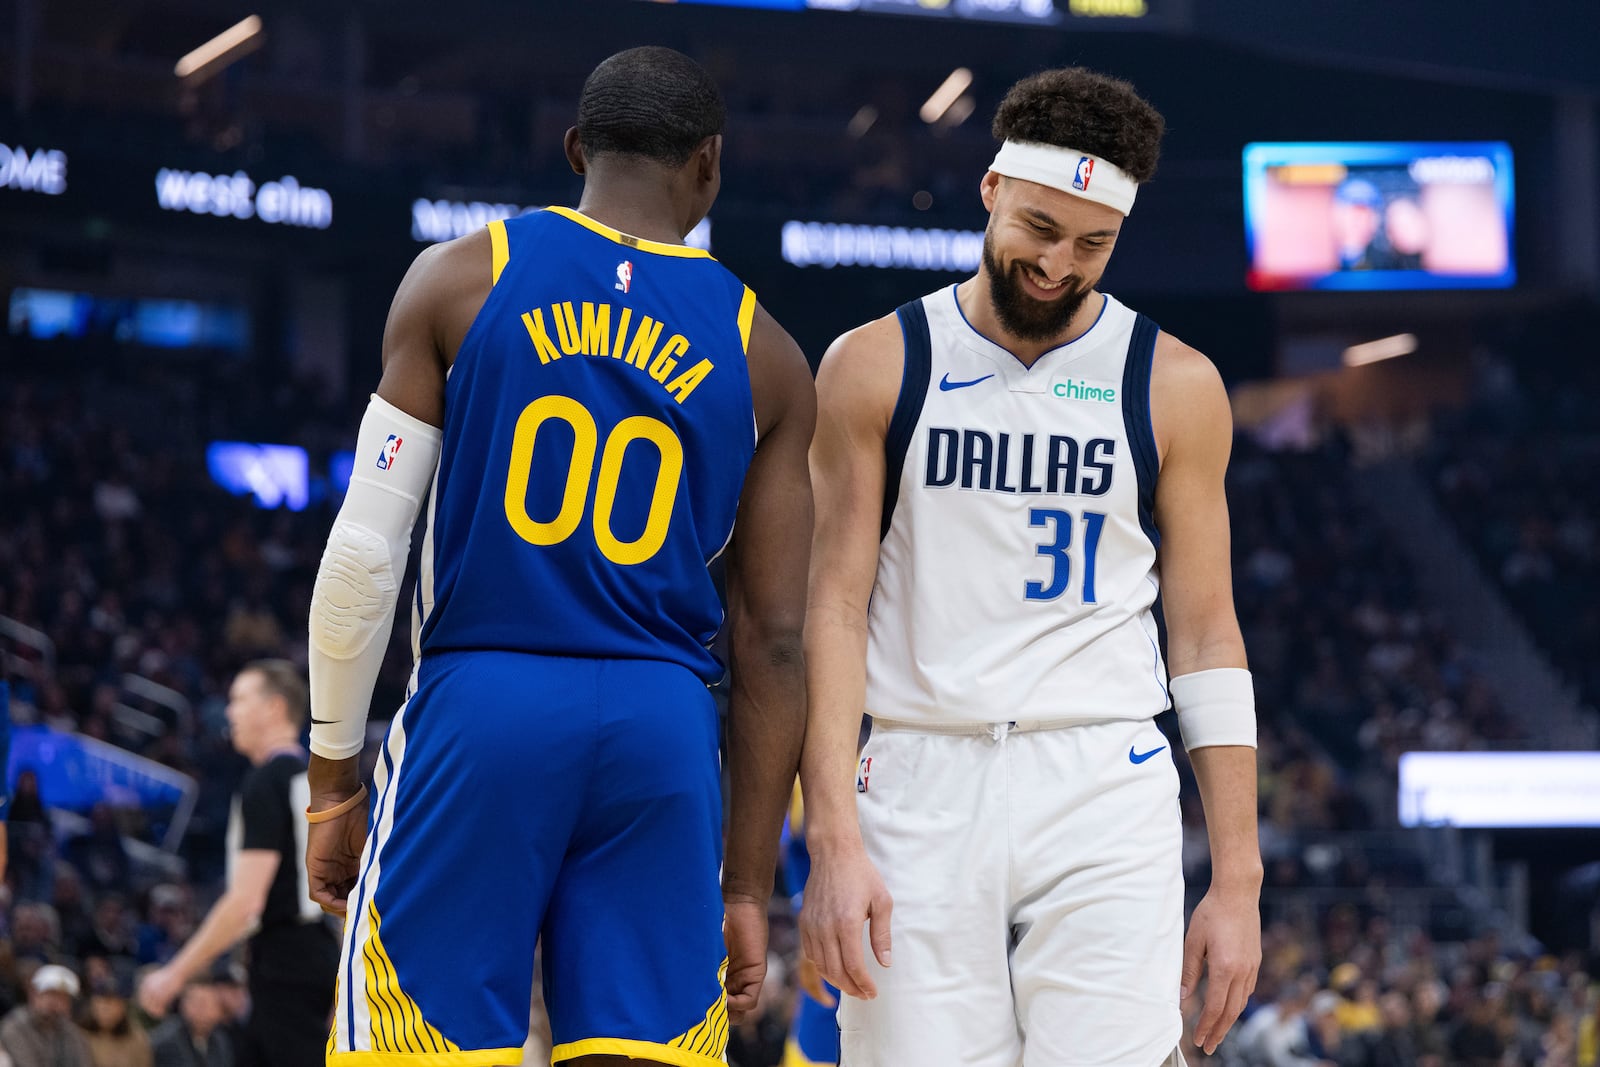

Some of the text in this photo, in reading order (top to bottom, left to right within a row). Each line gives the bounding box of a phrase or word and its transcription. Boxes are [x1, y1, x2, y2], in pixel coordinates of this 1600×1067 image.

[156, 167, 332, 229] west elm
[521, 301, 714, 404] KUMINGA
[1053, 378, 1115, 403] chime
[504, 394, 684, 566] 00
[923, 426, 1117, 498] DALLAS
[1023, 506, 1108, 606] 31
